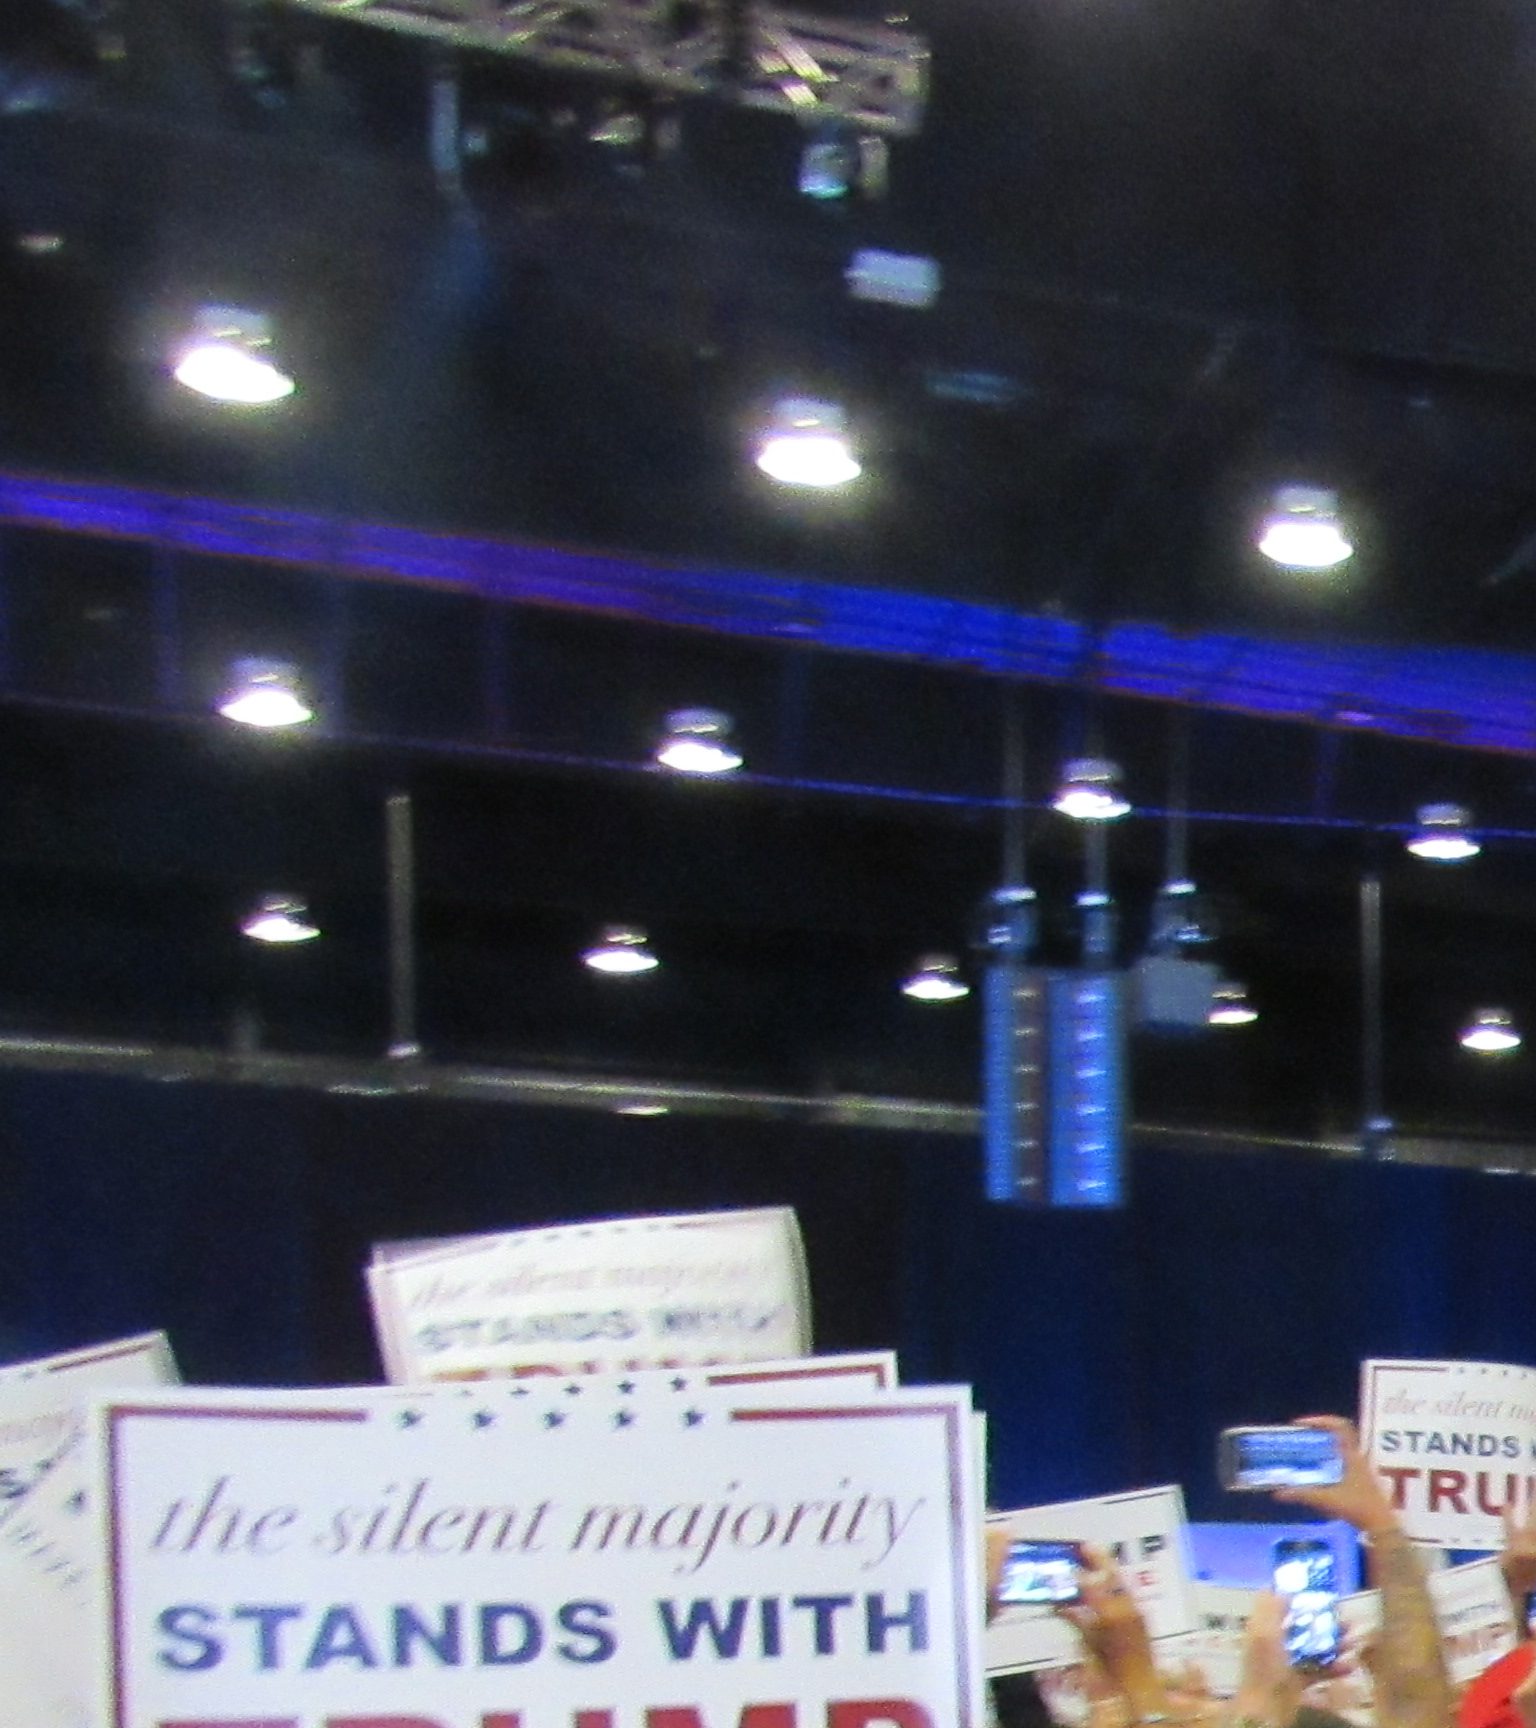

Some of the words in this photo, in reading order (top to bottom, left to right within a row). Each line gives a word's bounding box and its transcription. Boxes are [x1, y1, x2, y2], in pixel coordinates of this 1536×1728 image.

[1379, 1430, 1523, 1459] STANDS
[149, 1475, 300, 1554] the
[312, 1477, 551, 1554] silent
[570, 1477, 927, 1575] majority
[155, 1598, 618, 1672] STANDS
[656, 1589, 930, 1660] WITH
